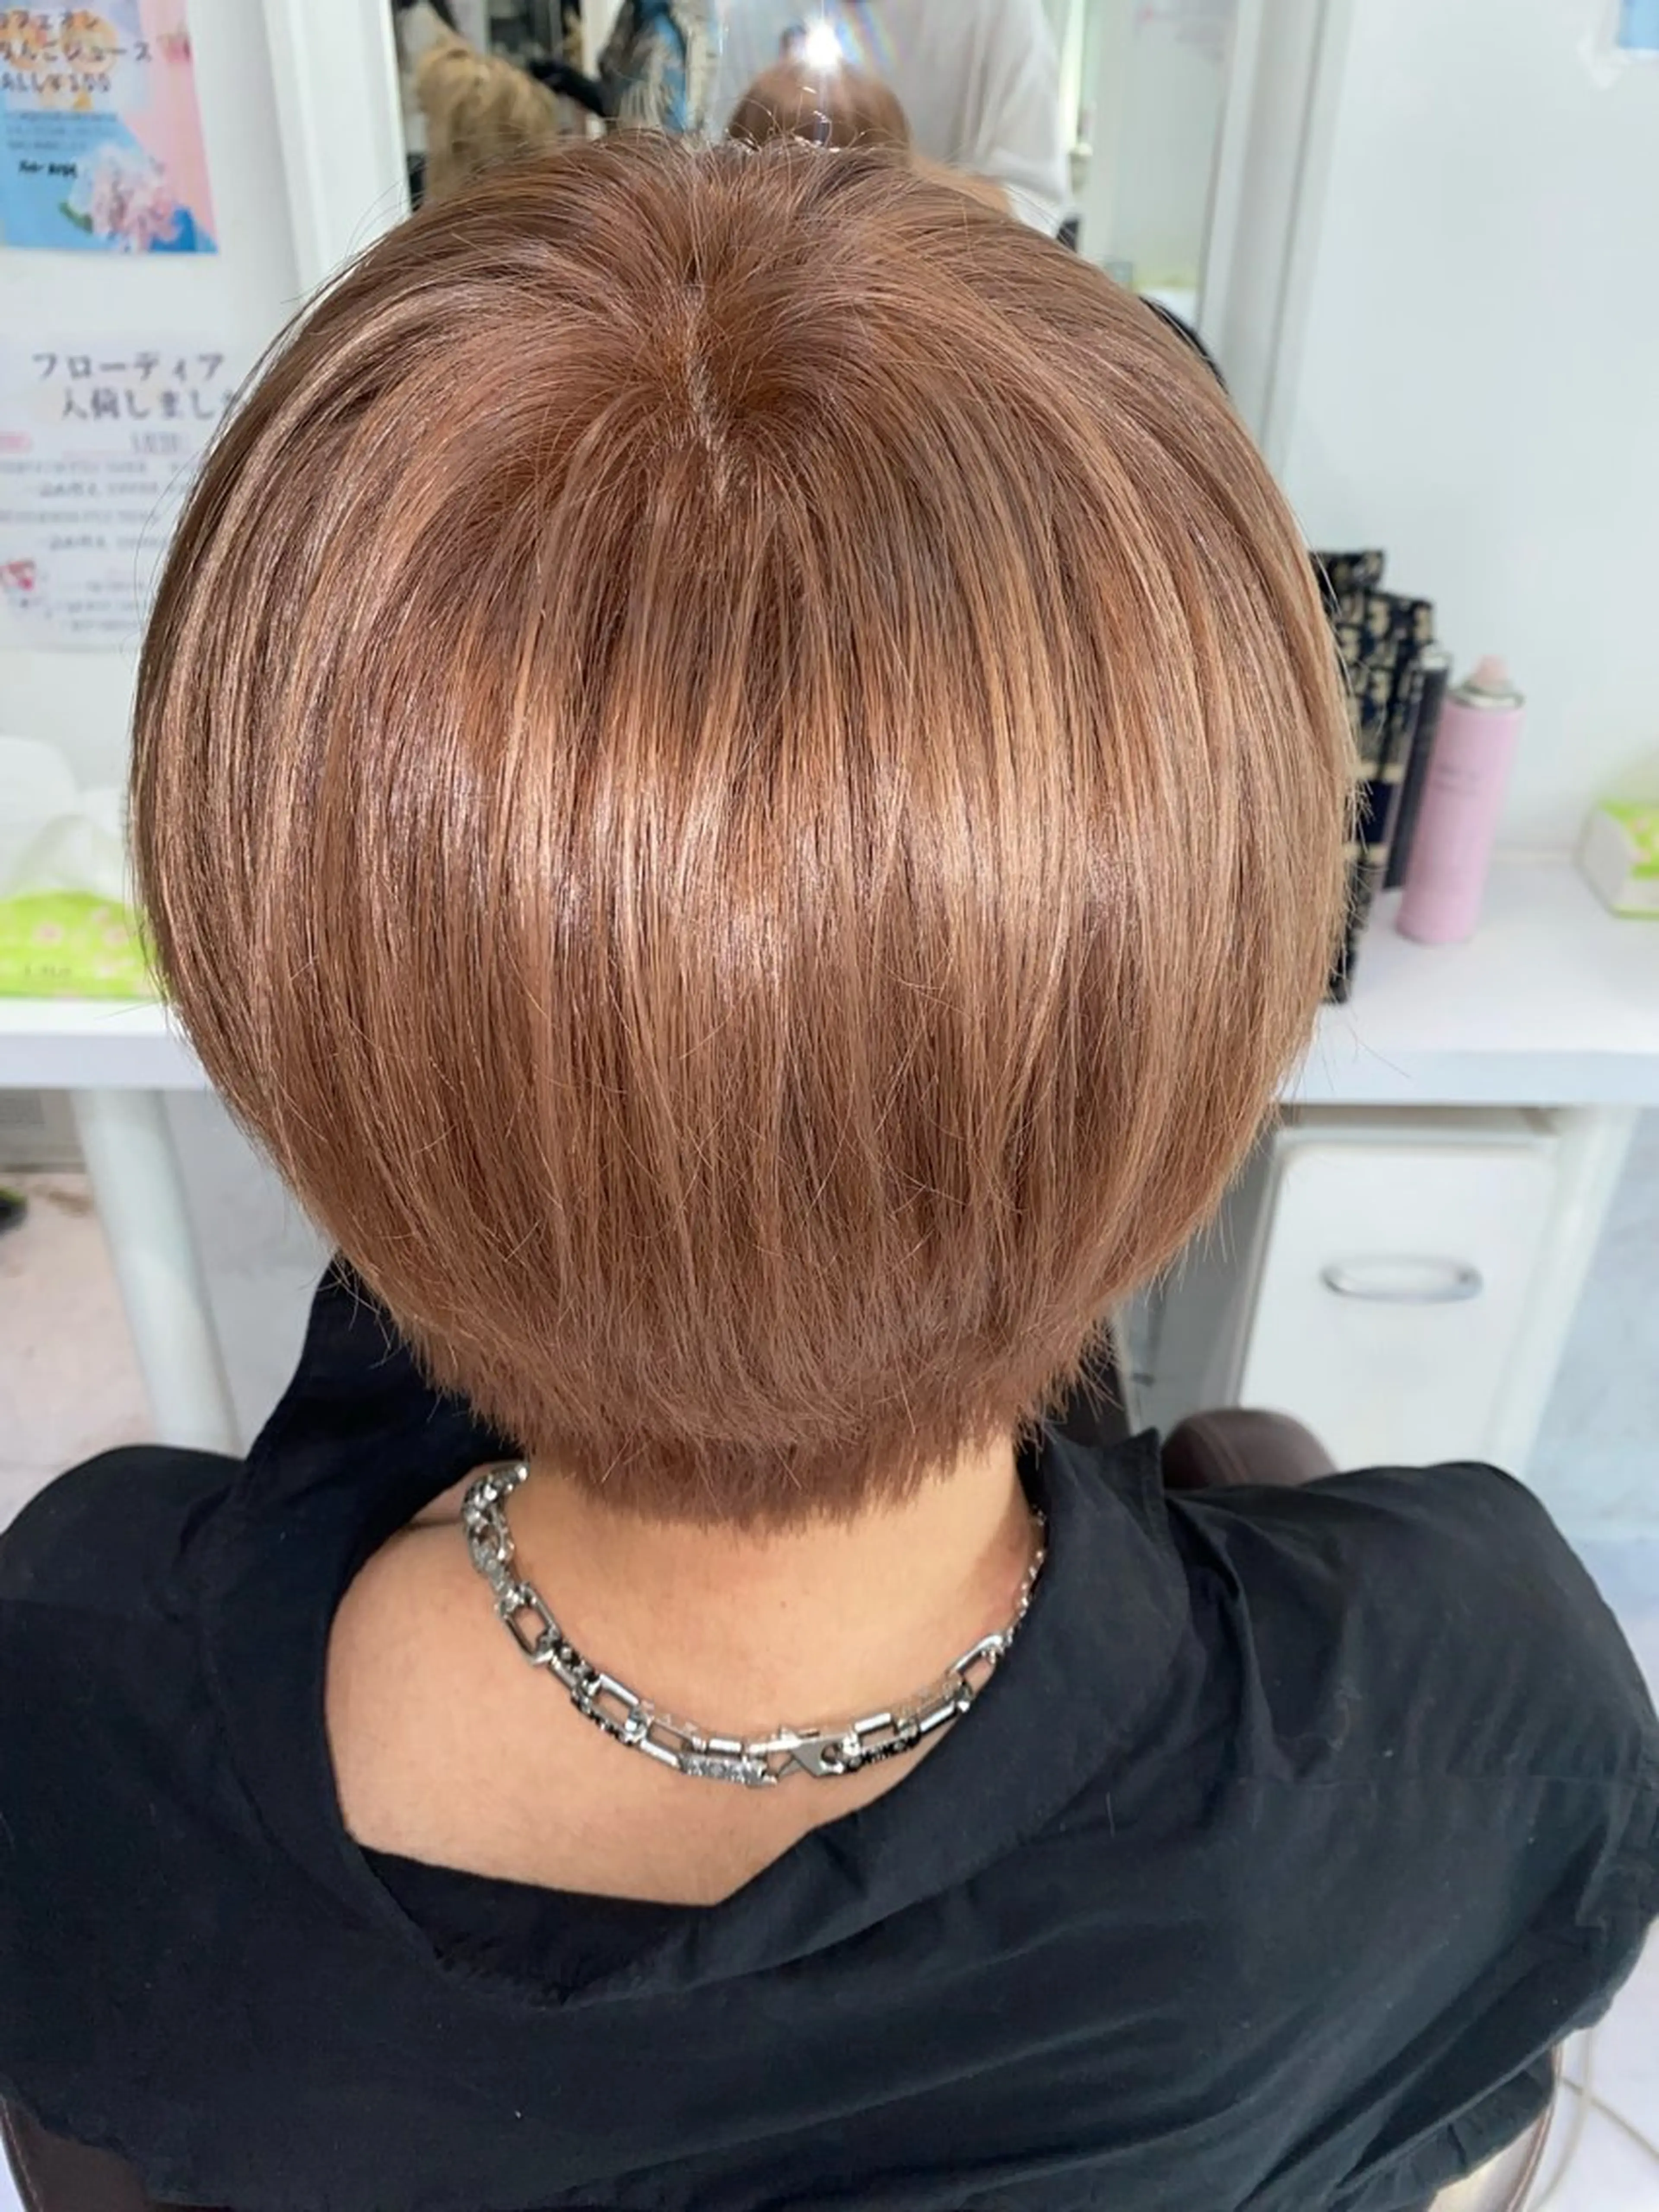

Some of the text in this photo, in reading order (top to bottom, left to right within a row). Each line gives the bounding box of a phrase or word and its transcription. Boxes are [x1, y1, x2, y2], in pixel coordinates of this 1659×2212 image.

[32, 352, 225, 381] フローディア
